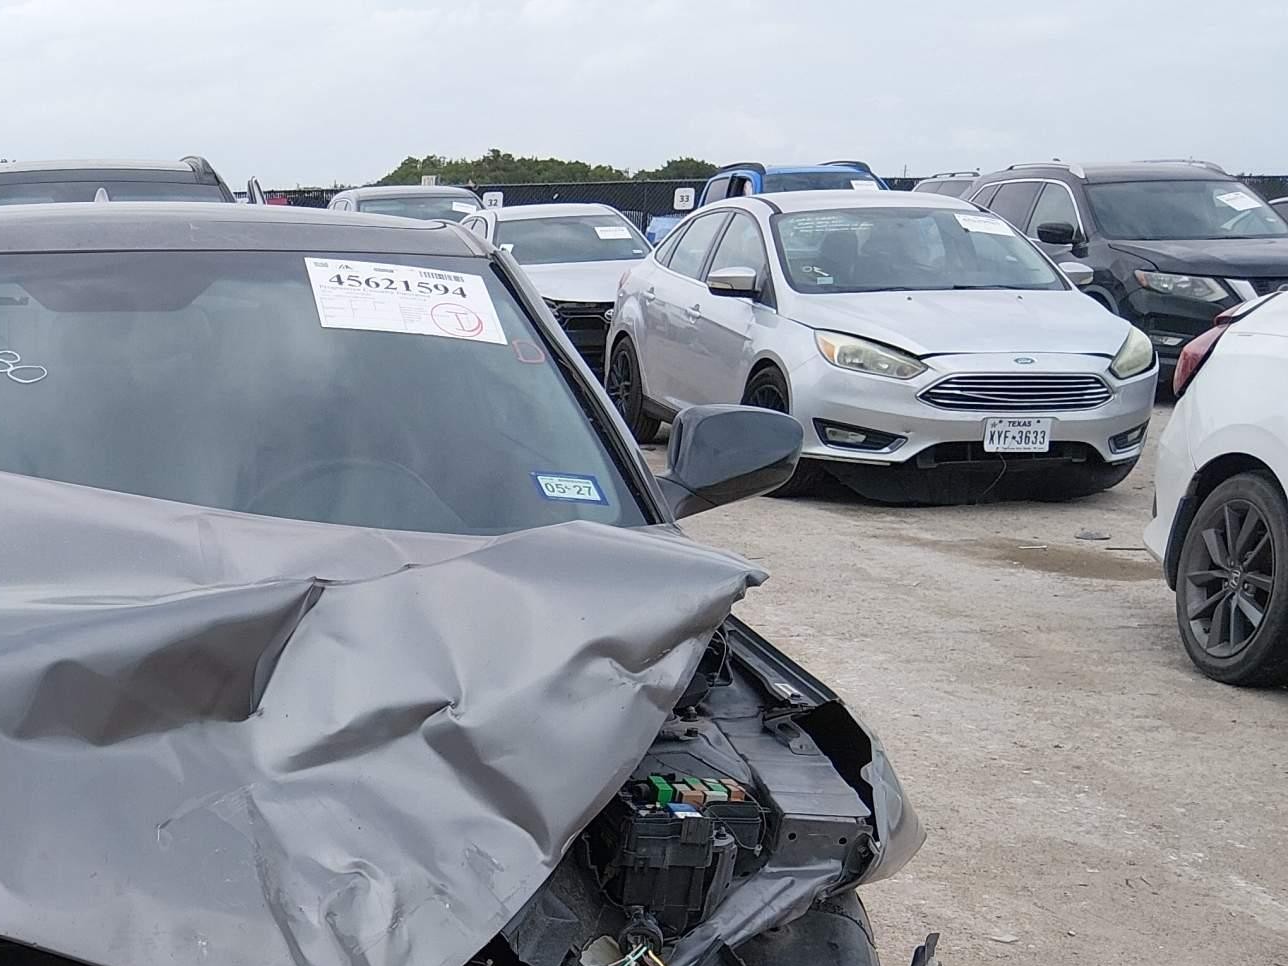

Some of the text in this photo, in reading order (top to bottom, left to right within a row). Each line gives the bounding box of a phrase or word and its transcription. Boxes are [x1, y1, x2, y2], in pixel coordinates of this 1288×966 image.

[487, 199, 498, 207] 32
[679, 195, 690, 203] 33
[328, 273, 468, 299] 45621594
